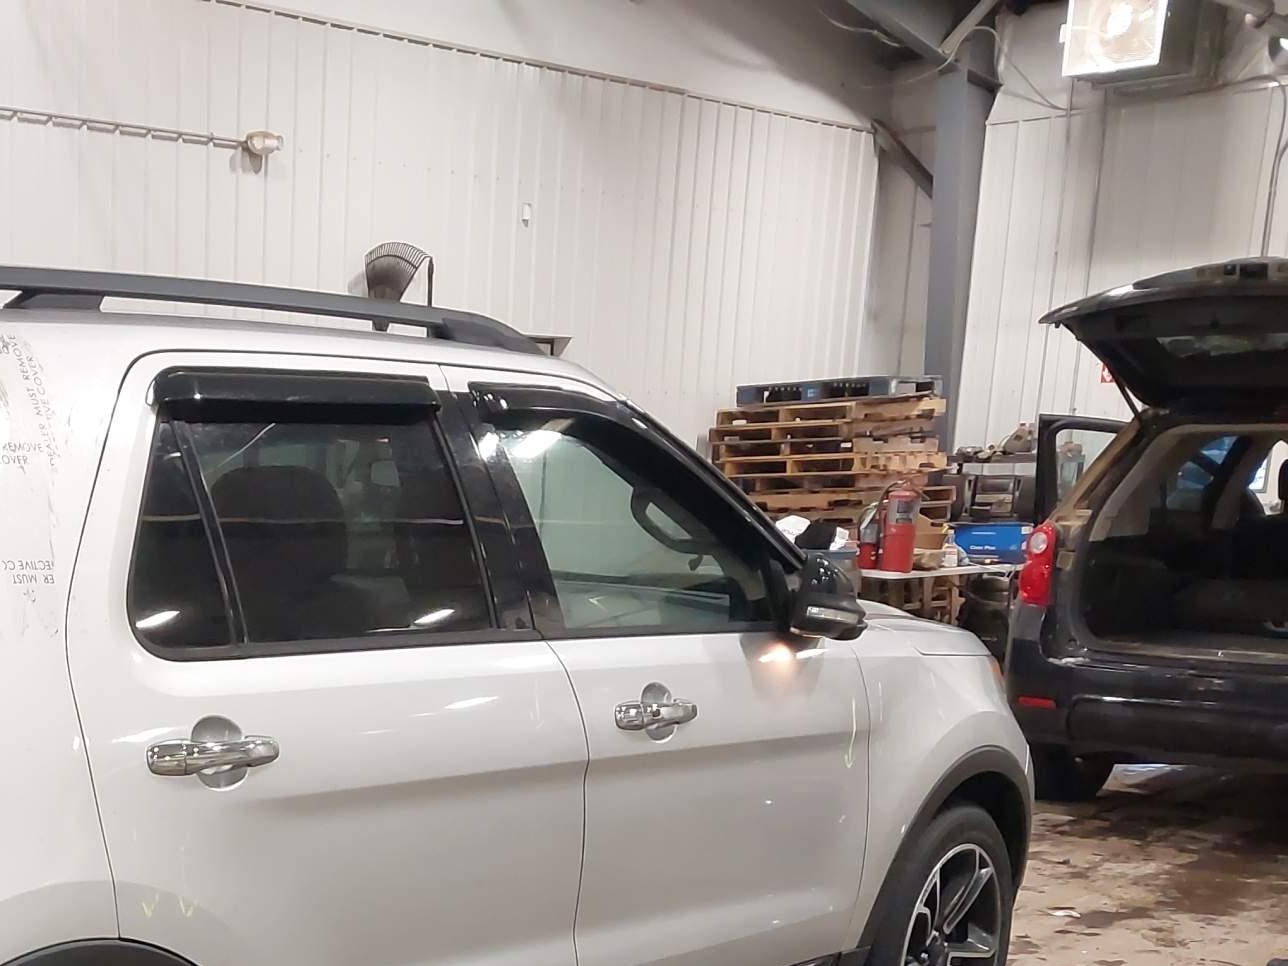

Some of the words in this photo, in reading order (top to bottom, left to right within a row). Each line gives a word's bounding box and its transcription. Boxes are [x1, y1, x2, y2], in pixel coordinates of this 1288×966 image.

[26, 355, 47, 396] COVER
[26, 387, 42, 416] MUST
[11, 573, 38, 585] MUST
